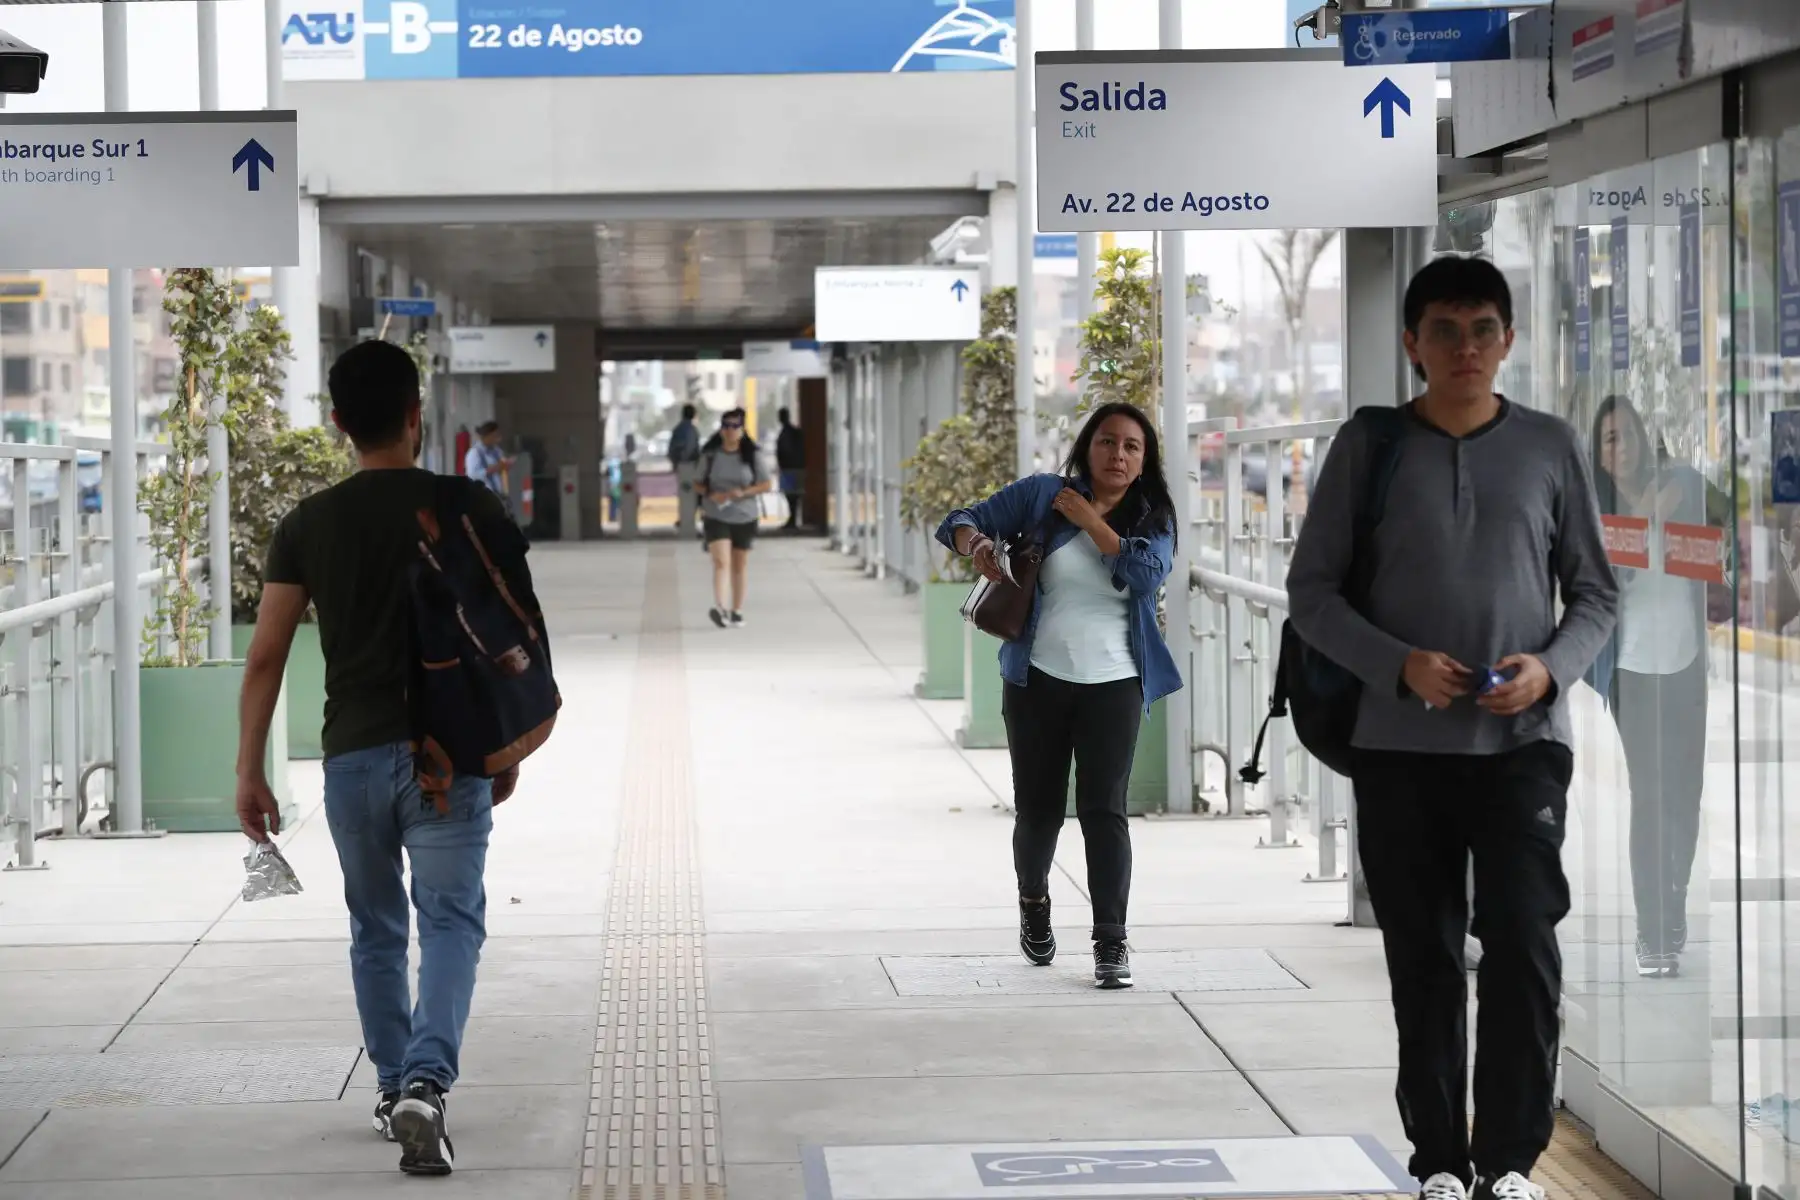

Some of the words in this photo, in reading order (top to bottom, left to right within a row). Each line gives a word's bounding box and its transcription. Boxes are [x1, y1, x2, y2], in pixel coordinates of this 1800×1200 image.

[282, 13, 354, 45] ATU
[390, 1, 431, 55] B
[468, 24, 501, 48] 22
[507, 22, 545, 47] de
[548, 22, 642, 53] Agosto
[1392, 28, 1462, 42] Reservado
[1059, 82, 1167, 111] Salida
[1062, 121, 1096, 139] Exit
[0, 139, 85, 162] barque
[92, 138, 130, 158] Sur
[137, 139, 149, 157] 1
[25, 167, 101, 185] boarding
[107, 167, 115, 182] 1
[1061, 193, 1097, 213] Av.
[1106, 193, 1136, 213] 22
[1143, 191, 1174, 213] de
[1181, 190, 1270, 216] Agosto
